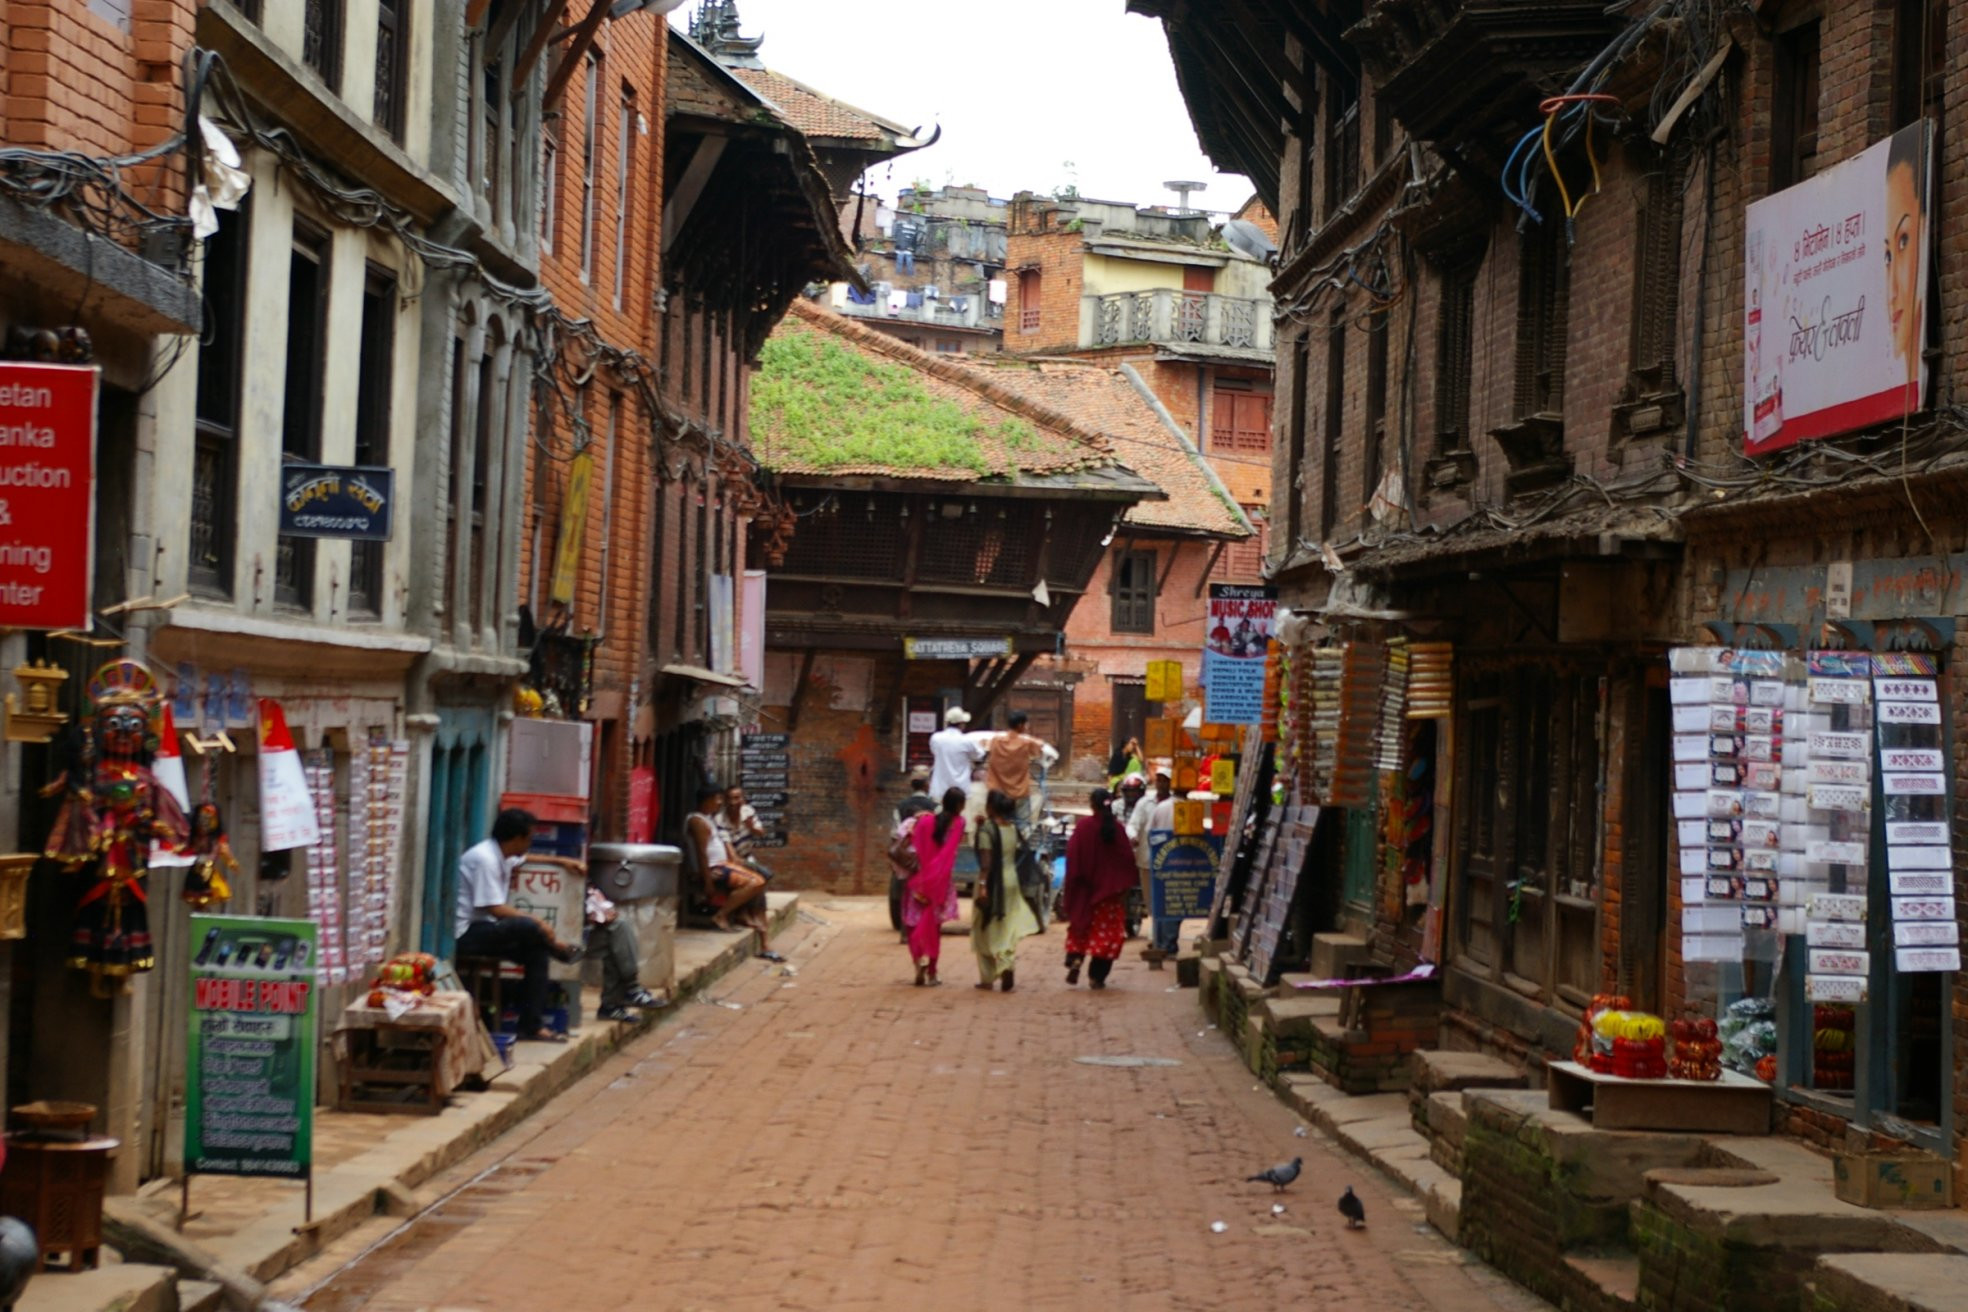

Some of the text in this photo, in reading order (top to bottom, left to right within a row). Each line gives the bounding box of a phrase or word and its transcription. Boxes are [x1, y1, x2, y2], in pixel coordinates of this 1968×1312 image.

[1211, 600, 1245, 617] MUSIC
[195, 978, 309, 1014] MOBILE POINT
